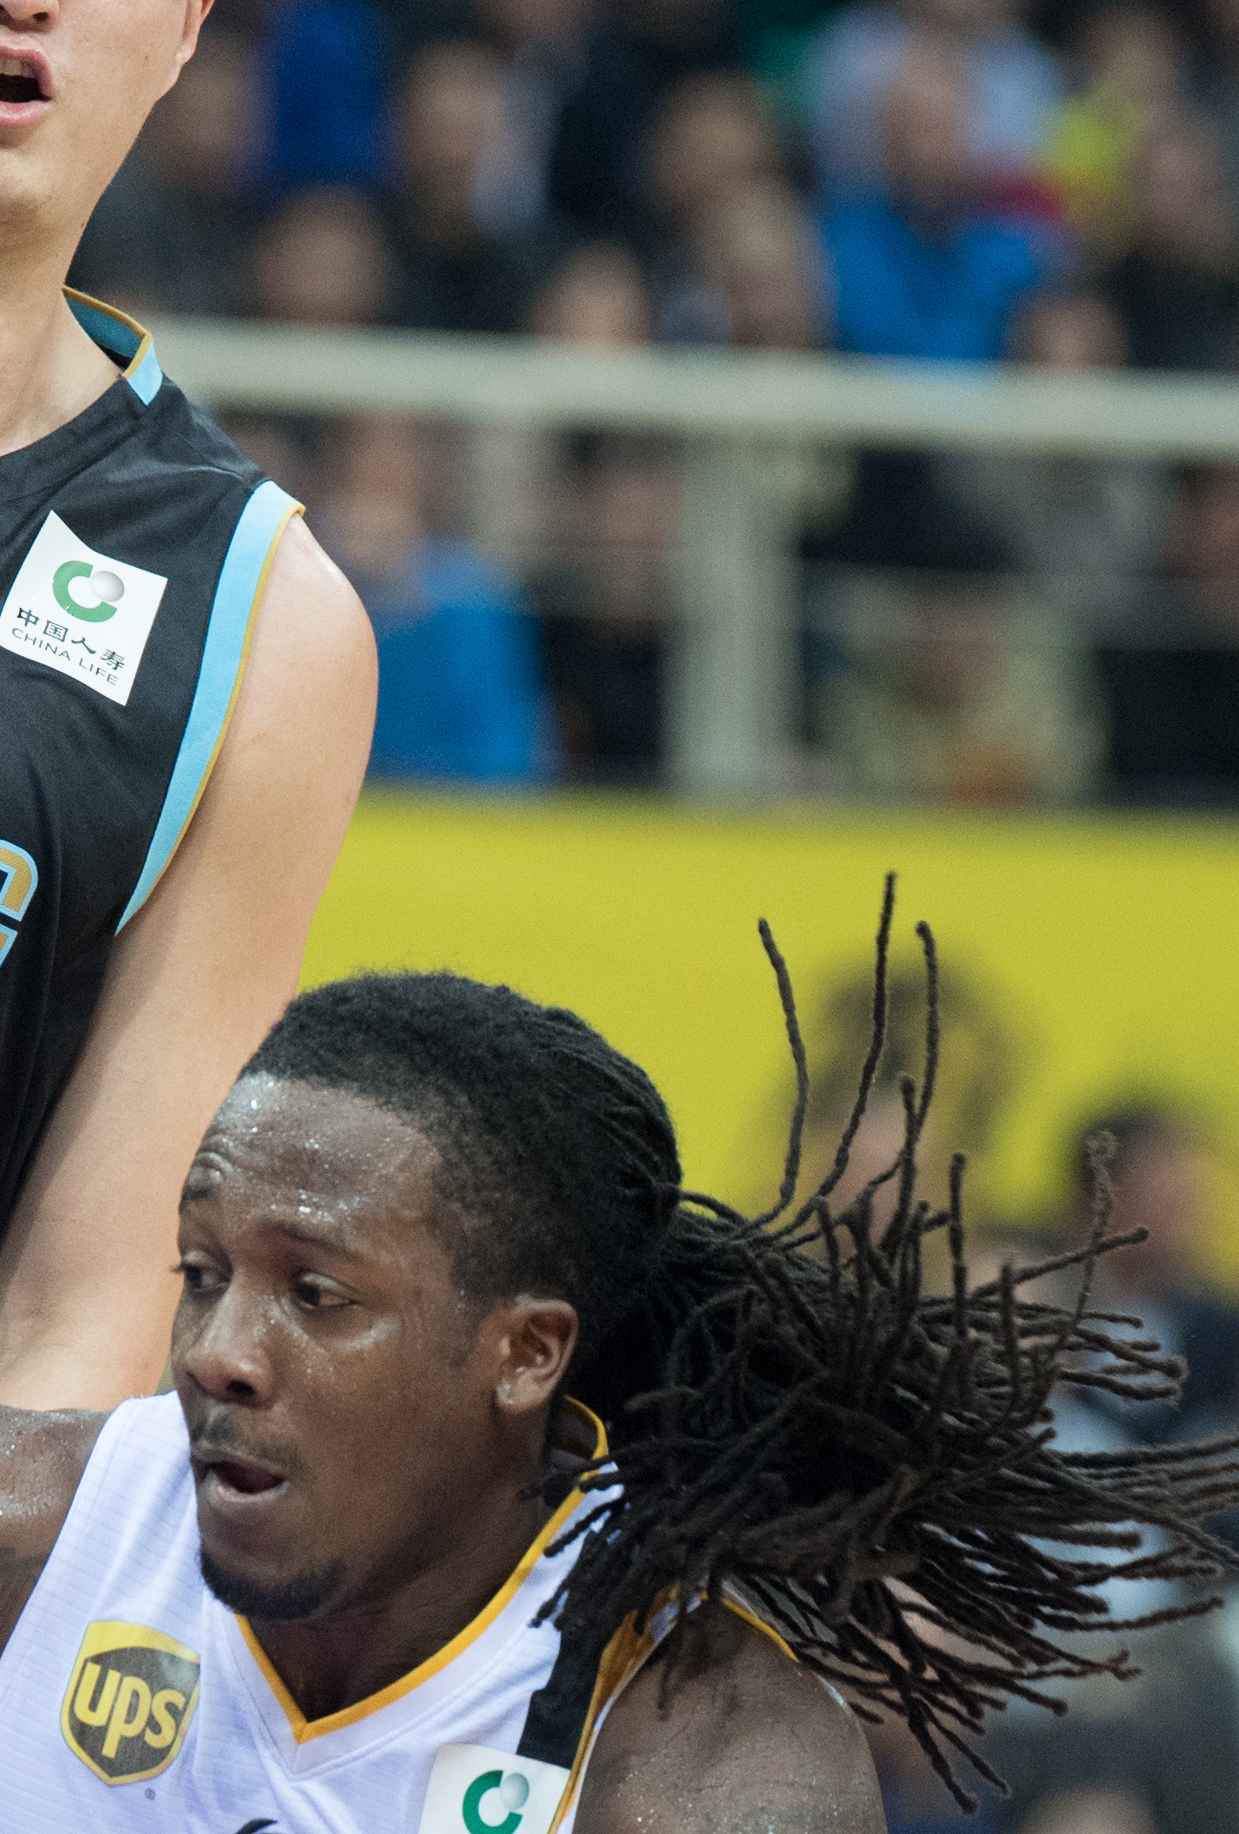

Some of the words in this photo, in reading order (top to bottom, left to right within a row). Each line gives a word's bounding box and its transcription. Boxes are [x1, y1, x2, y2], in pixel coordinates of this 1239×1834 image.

[12, 628, 71, 661] CHINA
[79, 658, 118, 685] LIFE
[17, 607, 125, 670] 中国人寿
[74, 1661, 186, 1759] ups
